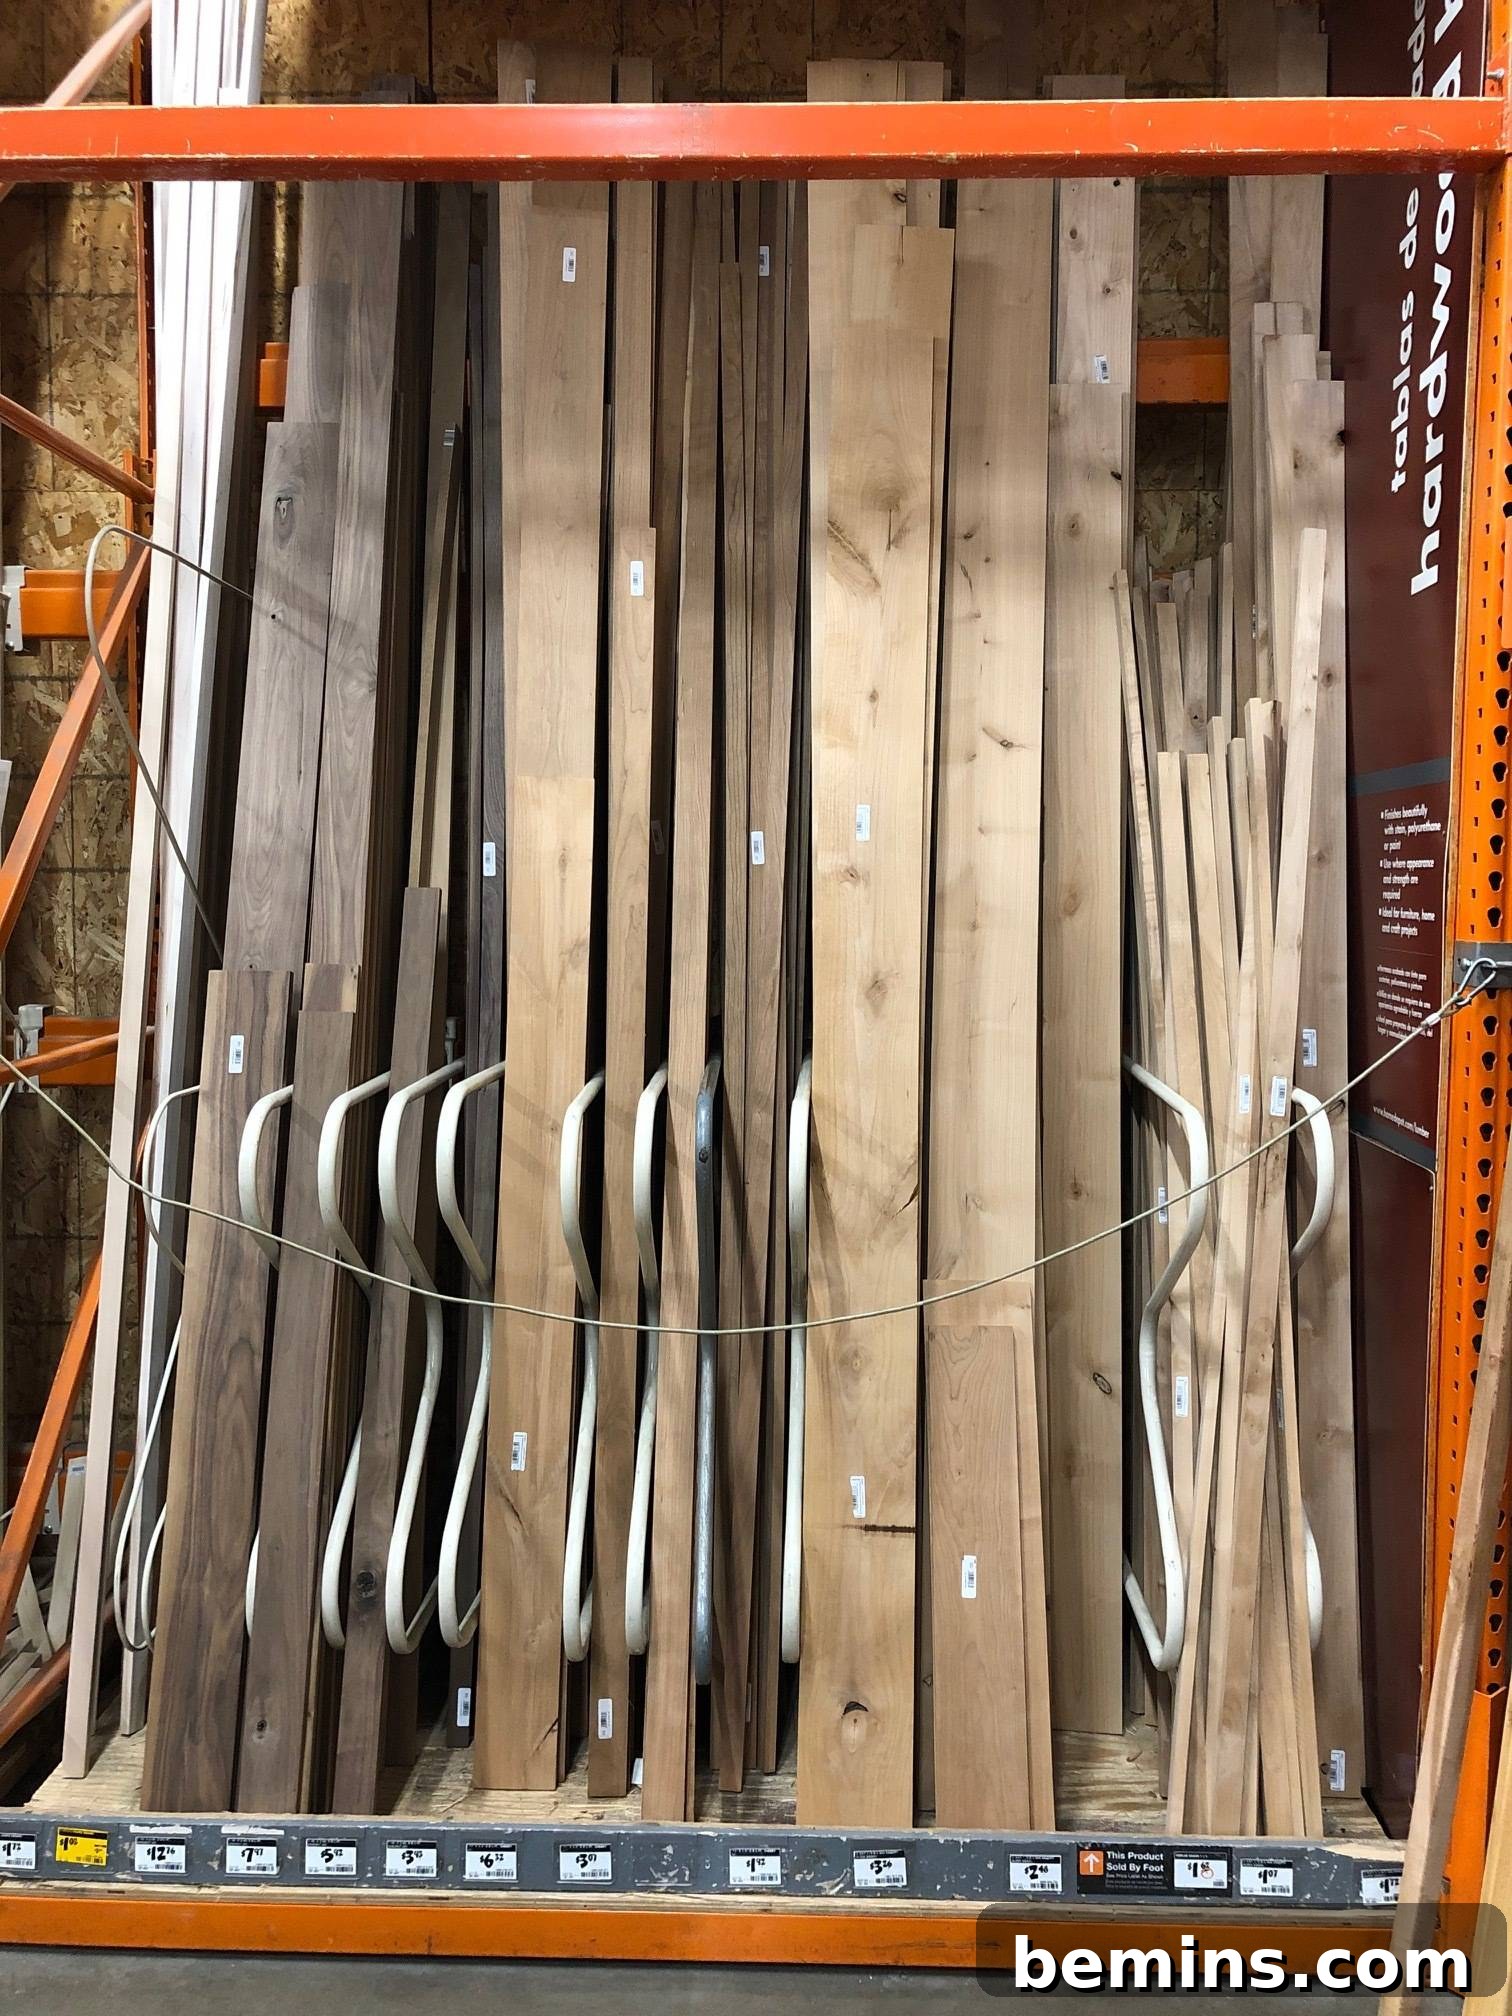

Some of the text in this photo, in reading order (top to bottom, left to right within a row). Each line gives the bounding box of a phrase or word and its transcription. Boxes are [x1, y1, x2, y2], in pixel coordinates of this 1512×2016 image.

[1399, 187, 1419, 269] de
[1411, 50, 1463, 595] hardwod
[1391, 290, 1414, 493] tablas
[1384, 804, 1428, 820] Finishes beautifully
[1406, 859, 1434, 871] appearance
[1382, 888, 1400, 902] required
[1421, 907, 1435, 921] home
[1106, 1851, 1164, 1861] This Product
[1106, 1863, 1164, 1873] Sold By Foot
